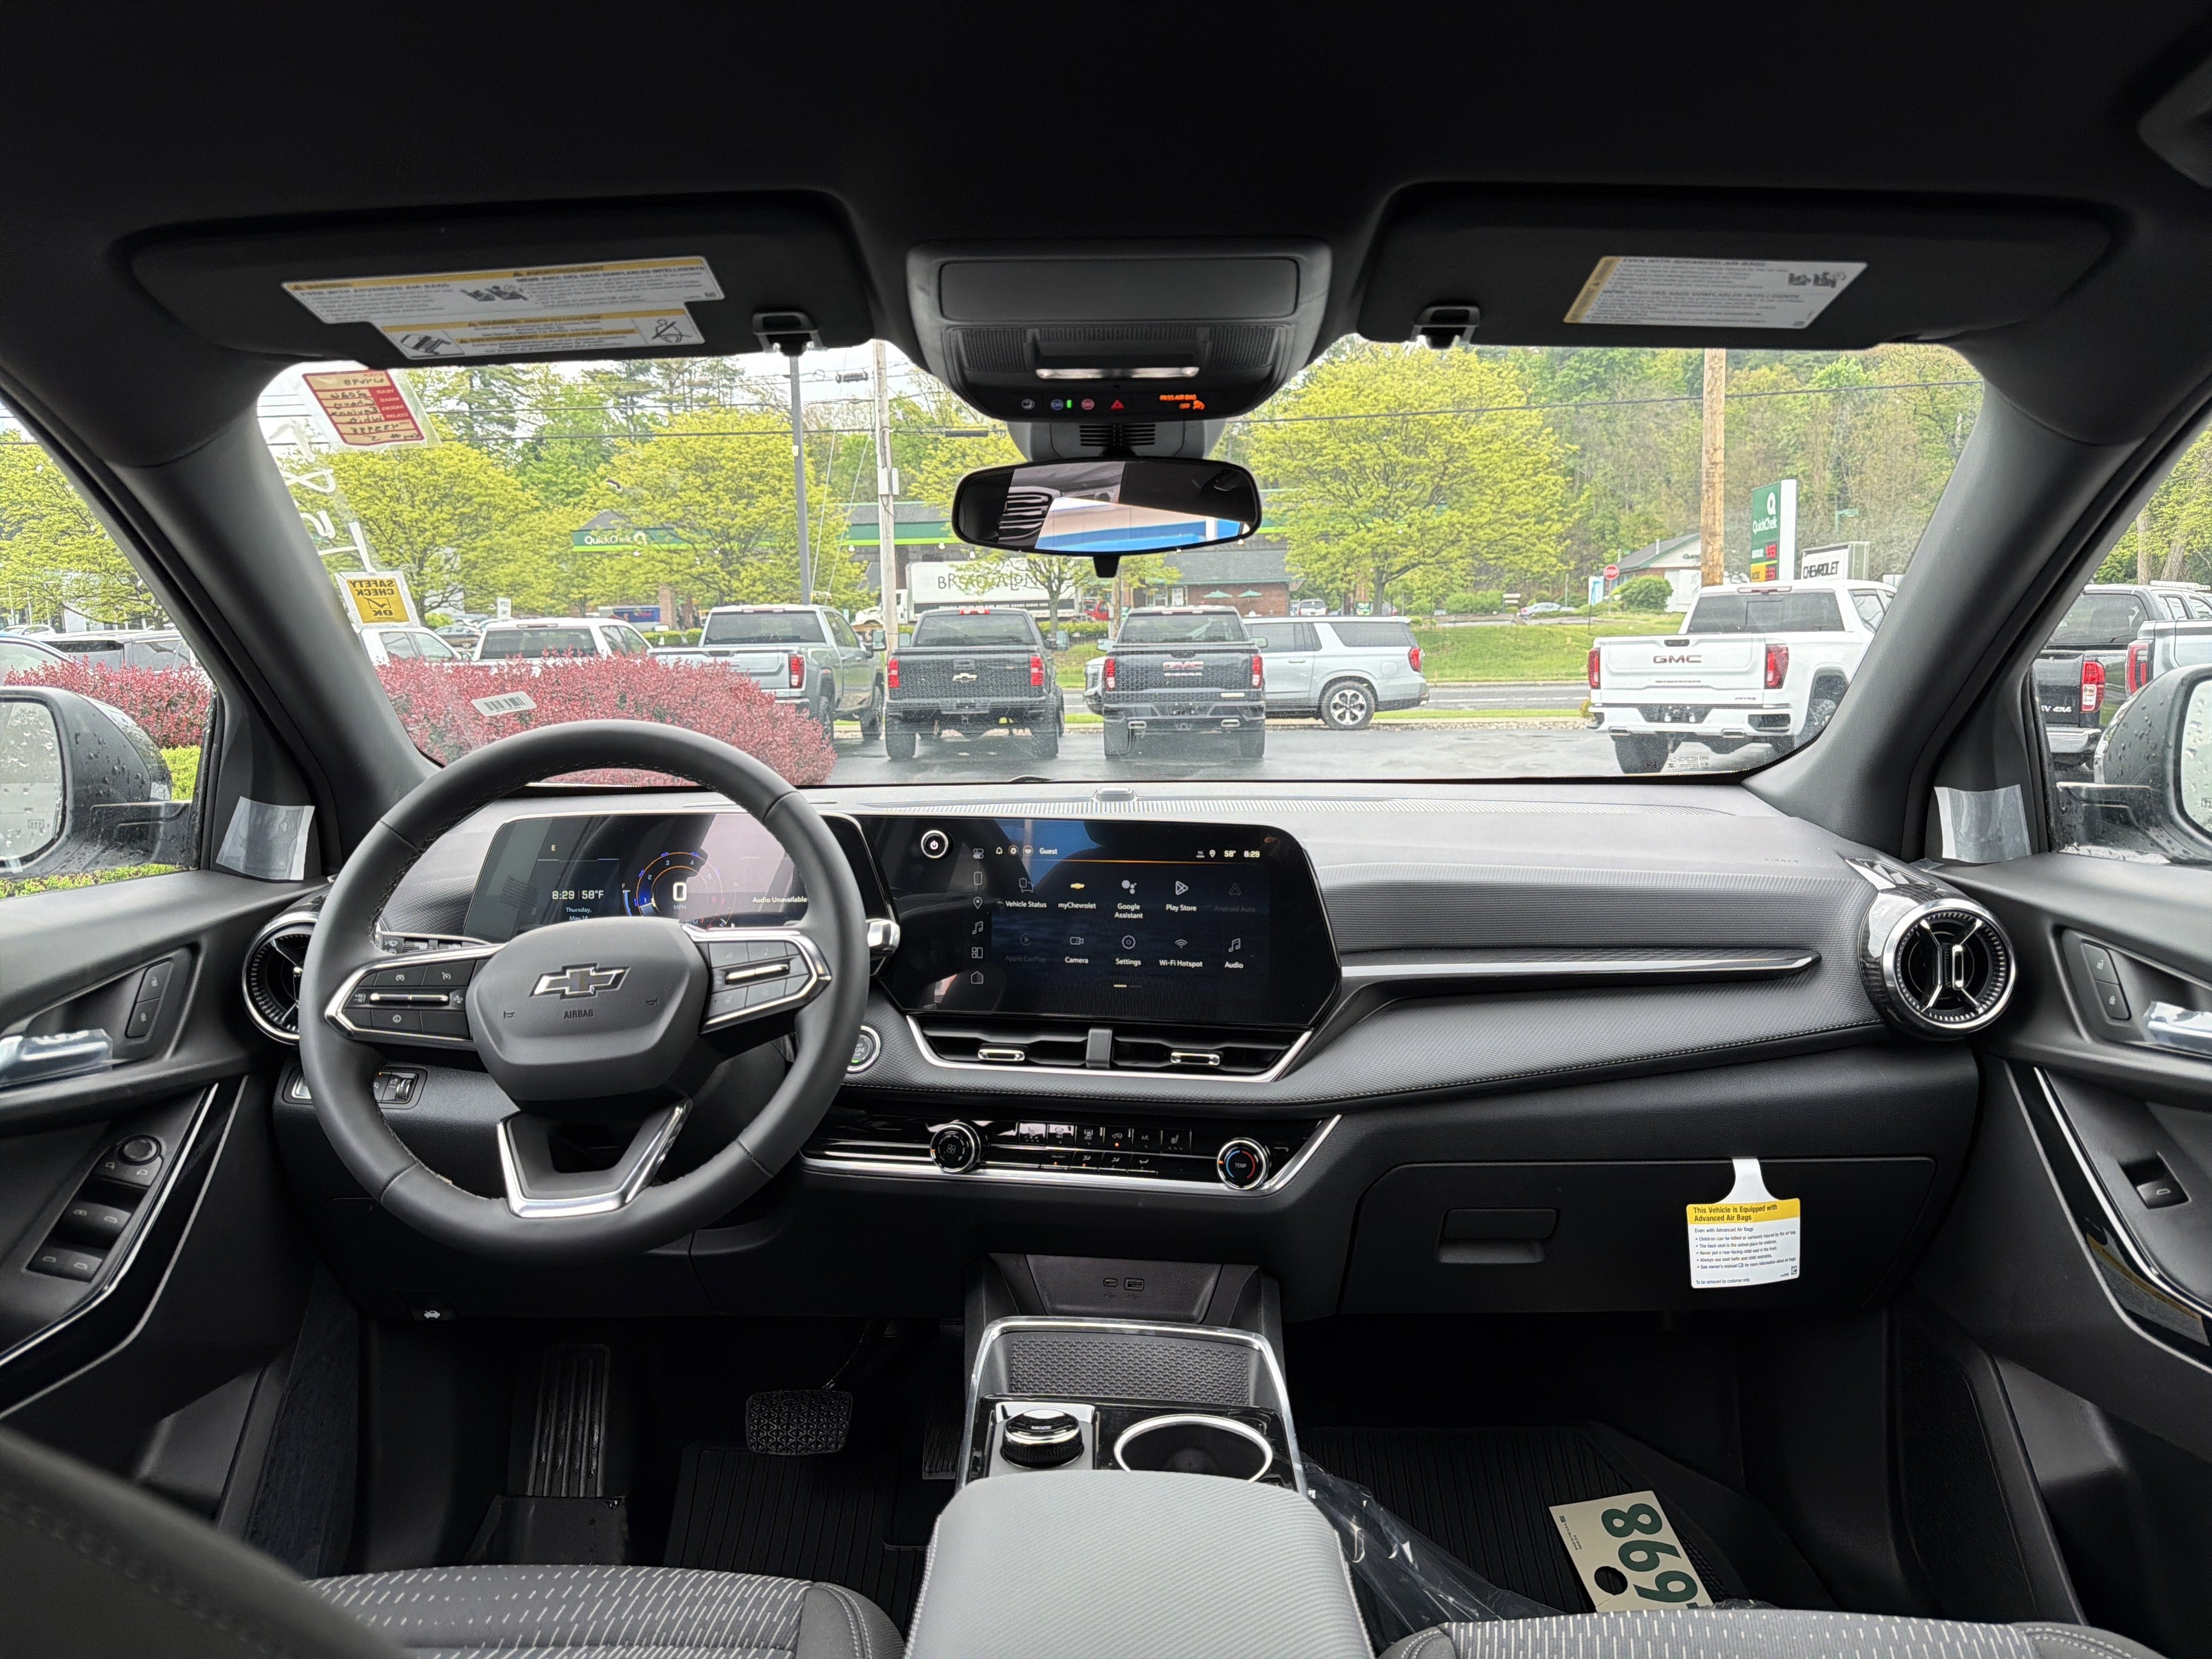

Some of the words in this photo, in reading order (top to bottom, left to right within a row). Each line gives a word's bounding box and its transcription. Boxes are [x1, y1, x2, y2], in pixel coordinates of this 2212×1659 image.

[1653, 655, 1702, 663] GMC
[552, 890, 574, 900] 8:29
[582, 890, 604, 900] 58°F
[673, 882, 687, 901] 0
[1118, 903, 1140, 911] Google
[1166, 904, 1179, 912] Play
[1115, 958, 1141, 967] Settings
[1177, 960, 1203, 968] Hotspot
[564, 1009, 594, 1019] AIRBAG
[1740, 1205, 1765, 1214] Equipped
[1601, 1503, 1699, 1609] 698
